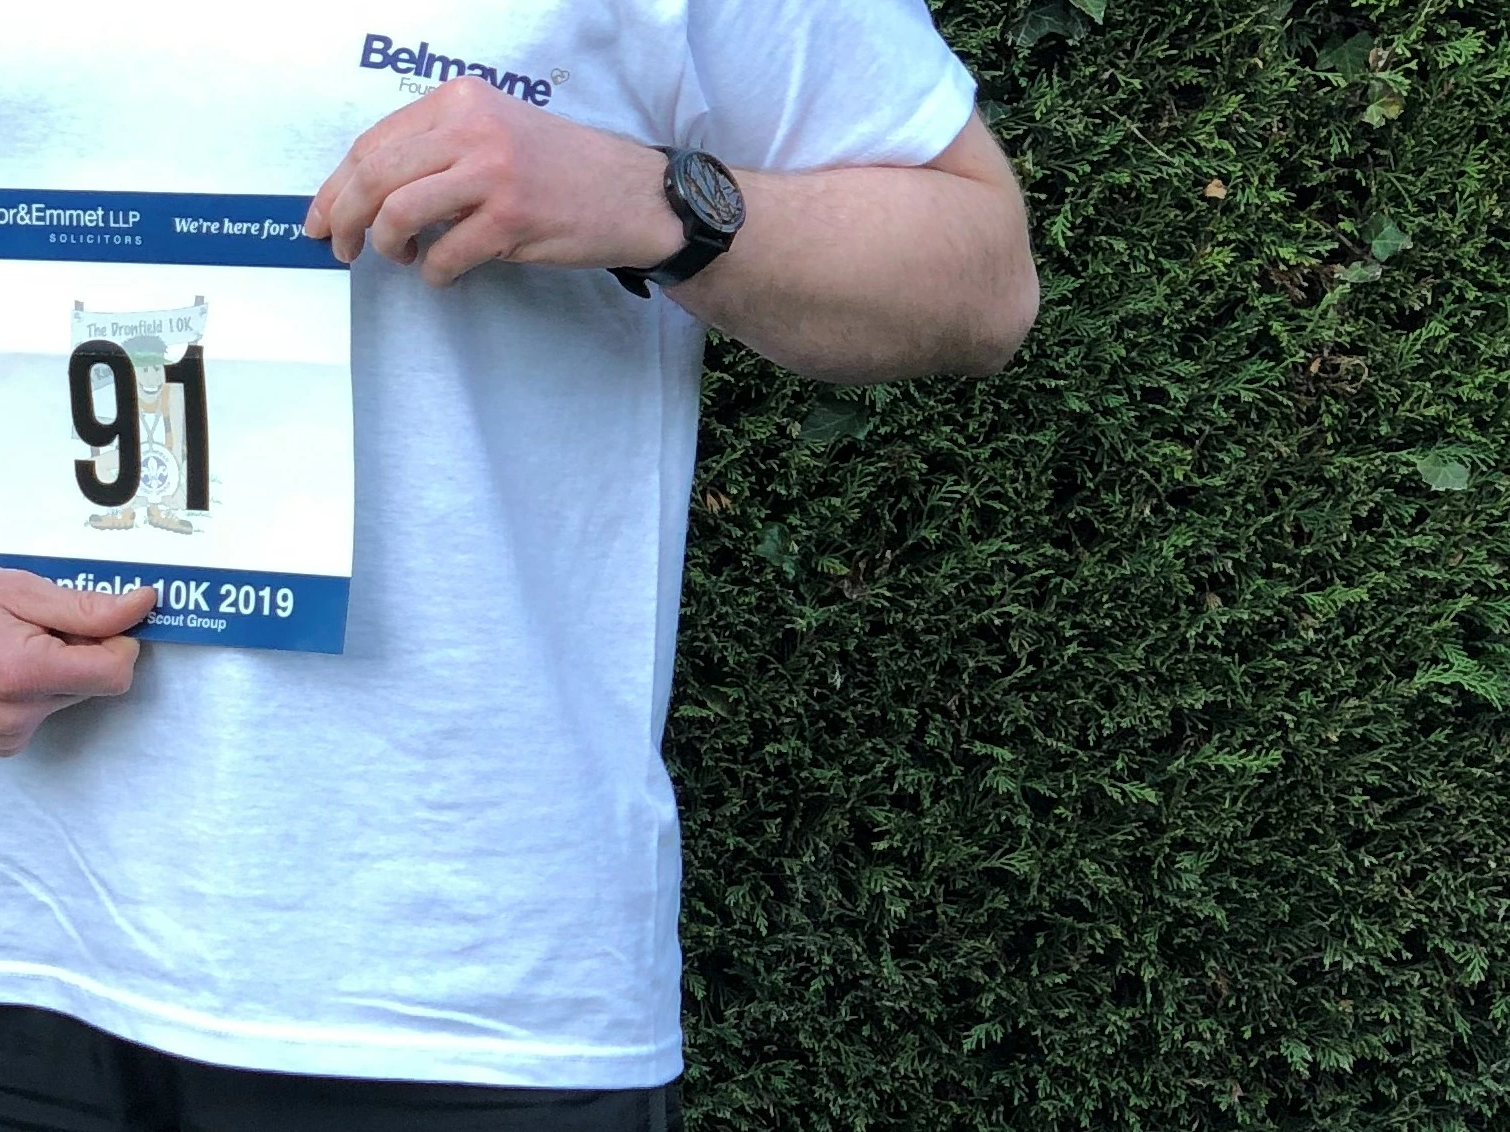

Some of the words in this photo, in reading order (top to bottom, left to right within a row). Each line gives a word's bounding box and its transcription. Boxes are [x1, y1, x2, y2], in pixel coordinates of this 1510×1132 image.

[109, 210, 141, 228] LLP
[223, 218, 259, 235] here
[261, 219, 289, 239] for
[49, 233, 143, 246] SOLICITORS
[87, 323, 107, 337] The
[111, 320, 163, 336] Dronfield
[68, 339, 210, 512] 91
[153, 578, 210, 612] 10K
[219, 584, 294, 618] 2019
[147, 612, 184, 626] Scout
[186, 614, 227, 633] Group
